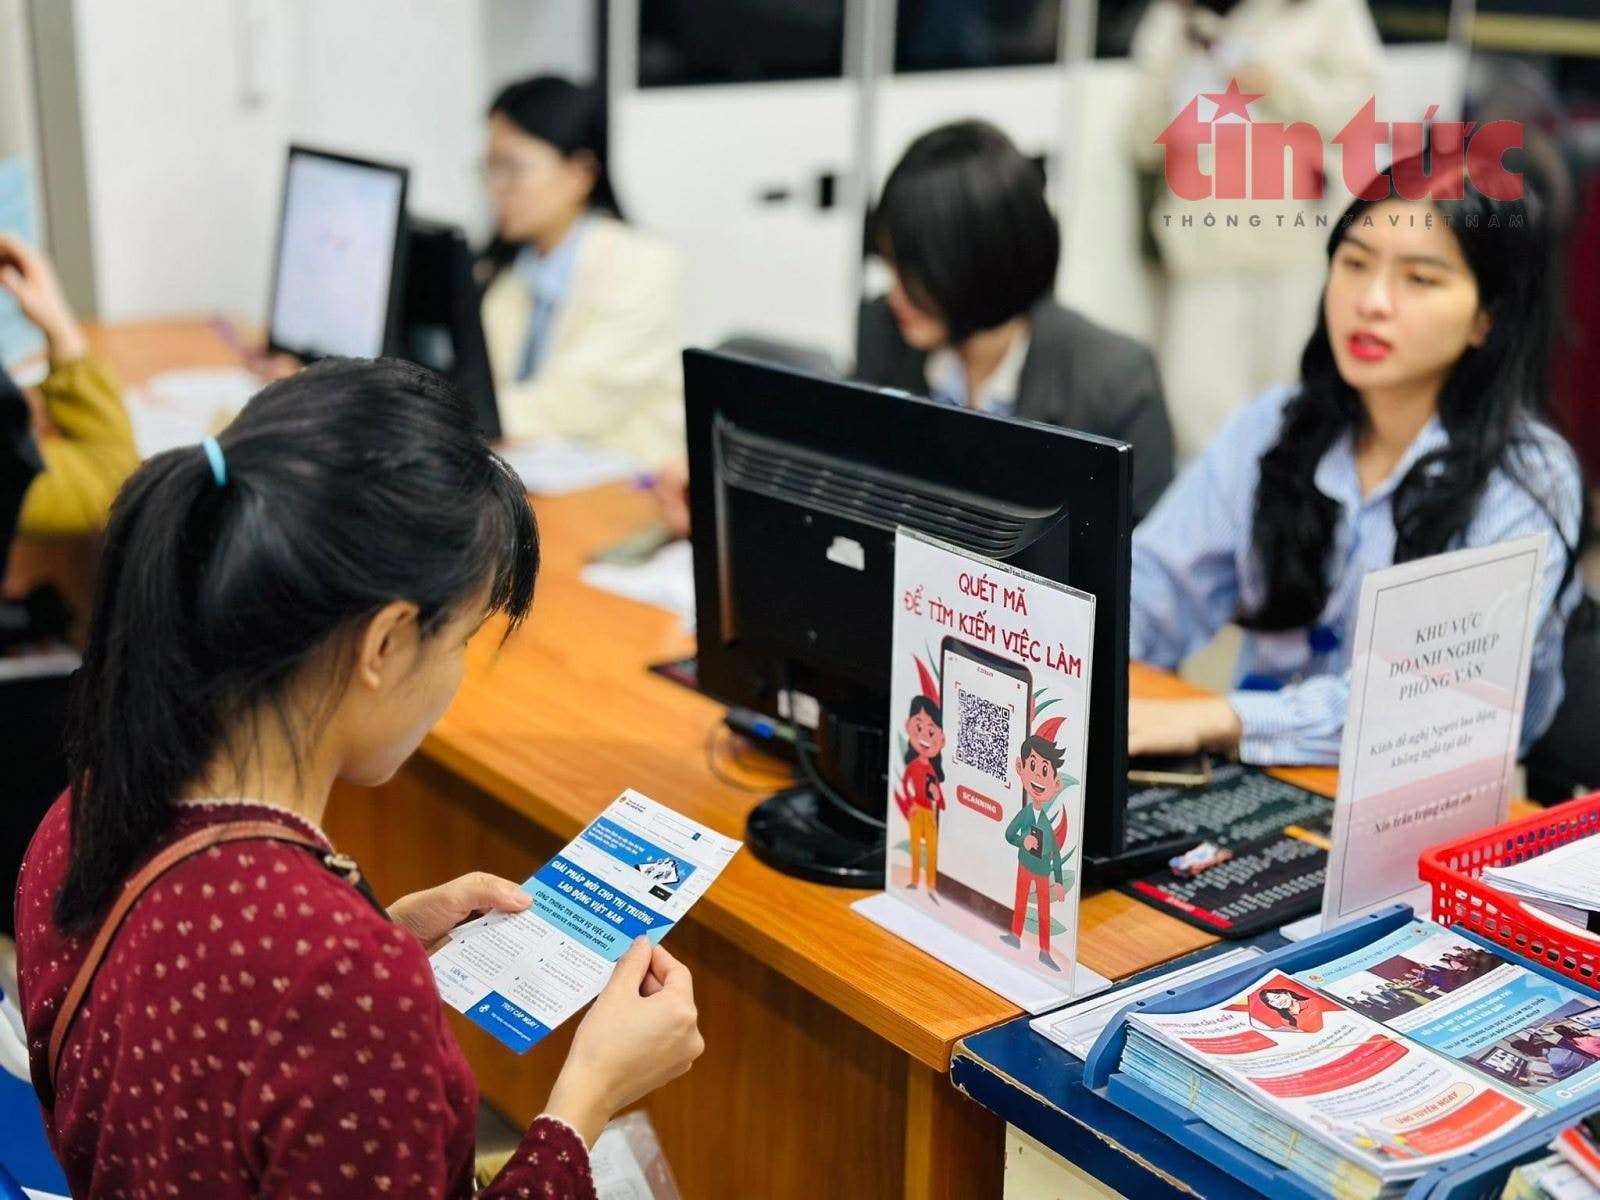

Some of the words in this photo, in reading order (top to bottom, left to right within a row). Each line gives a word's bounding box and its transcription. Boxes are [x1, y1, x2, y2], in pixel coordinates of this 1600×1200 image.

[959, 573, 997, 603] QUÉT
[1004, 587, 1028, 616] MÃ
[904, 585, 924, 615] ĐỂ
[928, 597, 953, 627] TÌM
[959, 610, 995, 644] KIẾM
[1002, 628, 1041, 662] VIỆC
[1047, 644, 1081, 678] LÀM
[1416, 622, 1448, 644] KHU
[1390, 649, 1442, 678] DOANH
[962, 791, 997, 814] SCANNING
[551, 860, 568, 874] GIẢI
[565, 868, 585, 884] PHÁP
[583, 878, 600, 893] MỚI
[598, 888, 613, 901] CHO
[612, 895, 625, 910] THỊ
[557, 881, 573, 893] LAO
[571, 888, 590, 904] ĐỘNG
[590, 898, 608, 914] VIỆT
[605, 908, 625, 924] NAM
